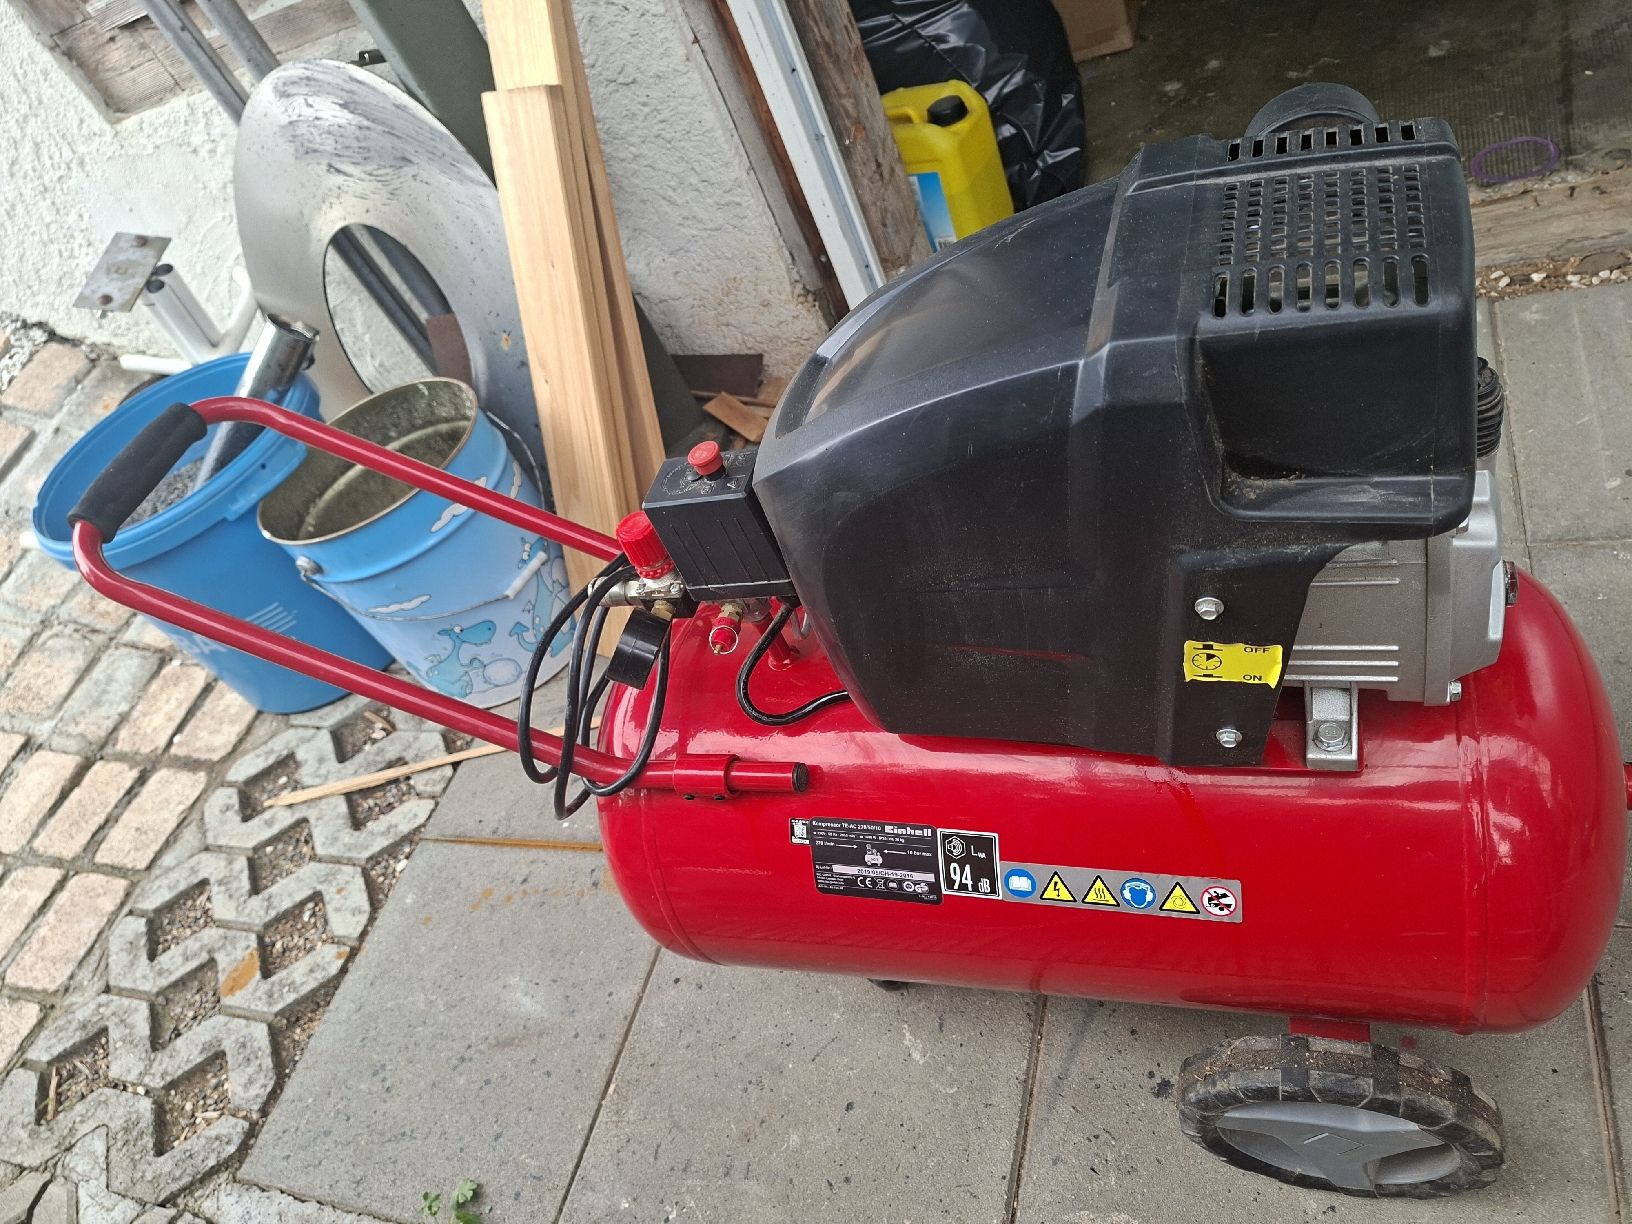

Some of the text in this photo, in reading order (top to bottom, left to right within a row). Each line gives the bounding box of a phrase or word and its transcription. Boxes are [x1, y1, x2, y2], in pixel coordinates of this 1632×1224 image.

[1243, 646, 1270, 654] OFF
[1243, 674, 1262, 682] ON
[884, 825, 932, 837] Einhell
[949, 862, 991, 893] 94 dB
